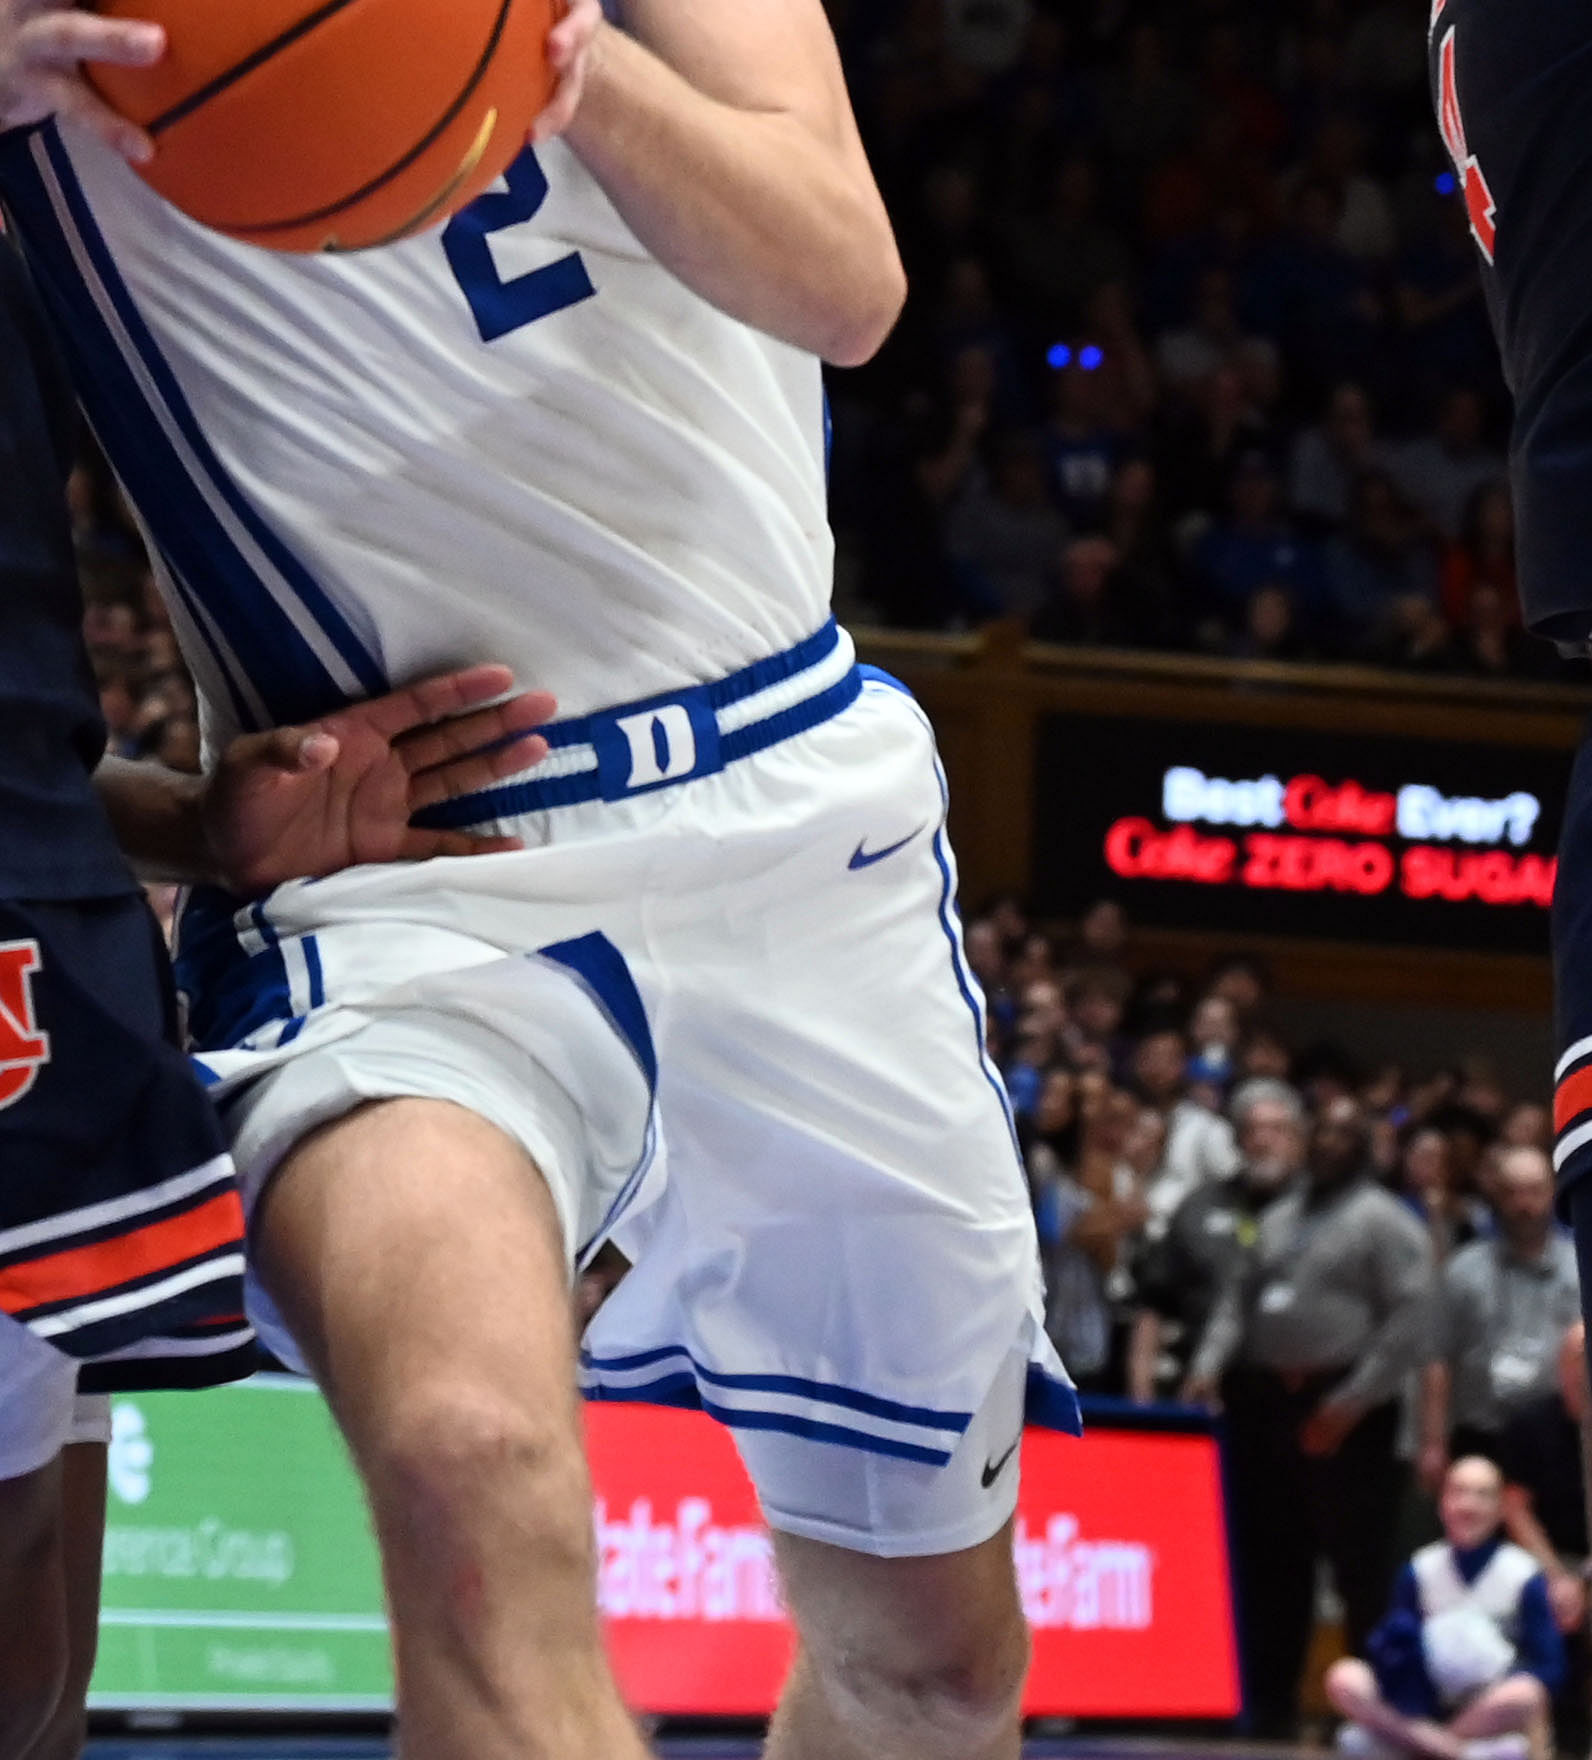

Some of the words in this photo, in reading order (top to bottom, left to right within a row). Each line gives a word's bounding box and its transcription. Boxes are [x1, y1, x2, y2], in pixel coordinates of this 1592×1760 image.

[440, 145, 598, 344] 2
[615, 702, 699, 789] D
[1162, 765, 1284, 830] Best
[1395, 781, 1540, 849] Ever?
[1104, 815, 1238, 884] Coke
[1239, 832, 1394, 896] ZERO
